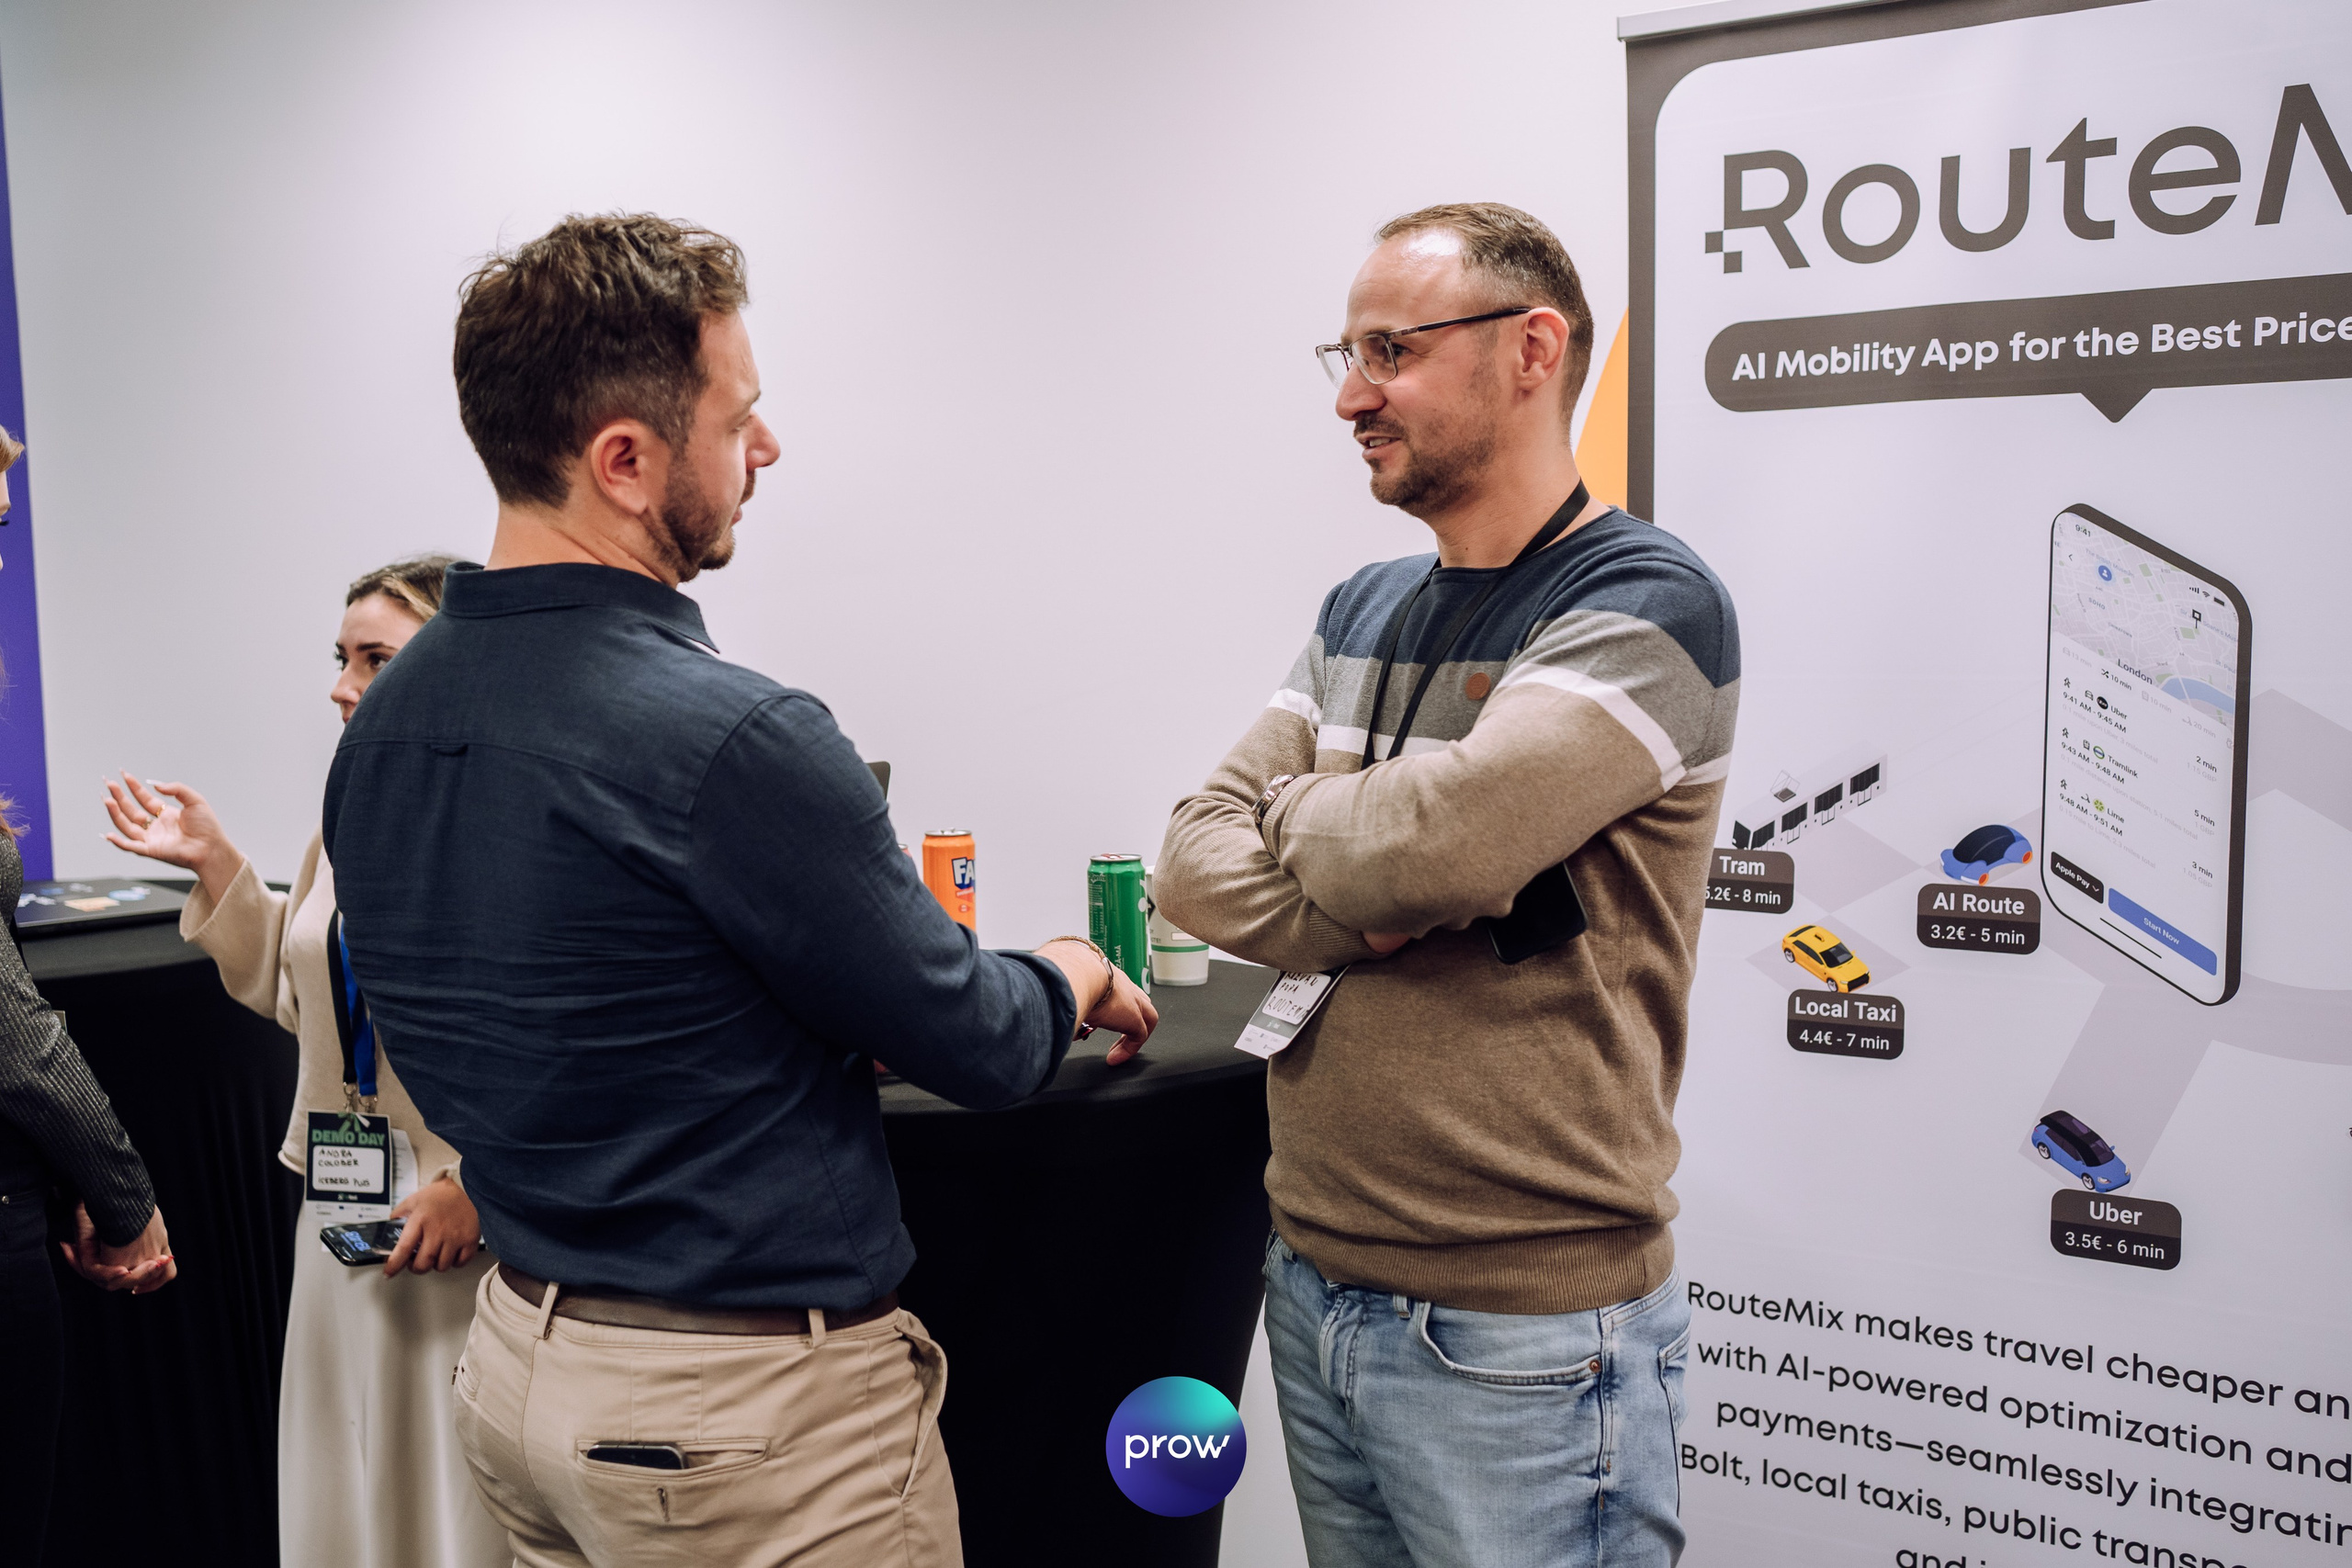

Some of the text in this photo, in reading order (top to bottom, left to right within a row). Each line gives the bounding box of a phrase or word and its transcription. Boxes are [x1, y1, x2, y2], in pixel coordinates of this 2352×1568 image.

[1732, 353, 1766, 380] AI
[1775, 341, 1916, 378] Mobility
[1922, 337, 1998, 371] App
[2009, 330, 2066, 364] for
[2074, 329, 2139, 357] the
[2153, 319, 2242, 352] Best
[2075, 525, 2091, 537] 9:41
[2111, 674, 2132, 691] 10 min
[2118, 658, 2153, 685] London
[2064, 692, 2077, 705] 9:41
[2079, 702, 2092, 714] AM
[2098, 712, 2113, 726] 9:45
[2114, 722, 2127, 733] AM
[2111, 705, 2128, 720] Uber
[2193, 721, 2216, 739] 20 min
[2061, 741, 2076, 755] 9:43
[2077, 752, 2090, 763] AM
[2096, 762, 2110, 776] 9:48
[2112, 773, 2124, 784] AM
[2108, 754, 2138, 779] Tramlink
[2196, 756, 2217, 773] 2 min
[2060, 793, 2075, 807] 9:48
[2076, 804, 2088, 816] AM
[2094, 814, 2109, 828] 9:51
[2110, 824, 2123, 837] AM
[2107, 807, 2125, 824] Lime
[2200, 814, 2215, 827] min
[1719, 855, 1766, 875] Tram
[2055, 862, 2090, 889] Apple Pay
[2192, 861, 2213, 879] 3 min
[1742, 888, 1752, 903] 8
[1755, 890, 1781, 905] min
[1933, 891, 2025, 916] AI Route
[1930, 925, 1966, 942] 3.2€
[1981, 928, 1991, 943] 5
[1995, 930, 2025, 945] min
[2143, 917, 2180, 945] Start Now
[1794, 996, 1897, 1023] Local Taxi
[1799, 1030, 1833, 1046] 4.4€
[1847, 1033, 1856, 1048] 7
[1860, 1035, 1890, 1051] min
[312, 1129, 385, 1145] DEMO DAY
[2089, 1201, 2143, 1225] Uber
[2064, 1231, 2101, 1251] 3.5€
[2117, 1239, 2128, 1255] 6
[2132, 1243, 2165, 1260] min
[1688, 1281, 1844, 1331] RouteMix
[1856, 1309, 1973, 1351] makes
[1984, 1330, 2093, 1373] travel
[2107, 1353, 2283, 1406] cheaper
[1697, 1342, 2352, 1484] with AI-powered optimization and
[1681, 1443, 1750, 1485] Bolt,
[1762, 1459, 1847, 1500] local
[1857, 1479, 1951, 1527] taxis,
[1964, 1506, 2082, 1551] public
